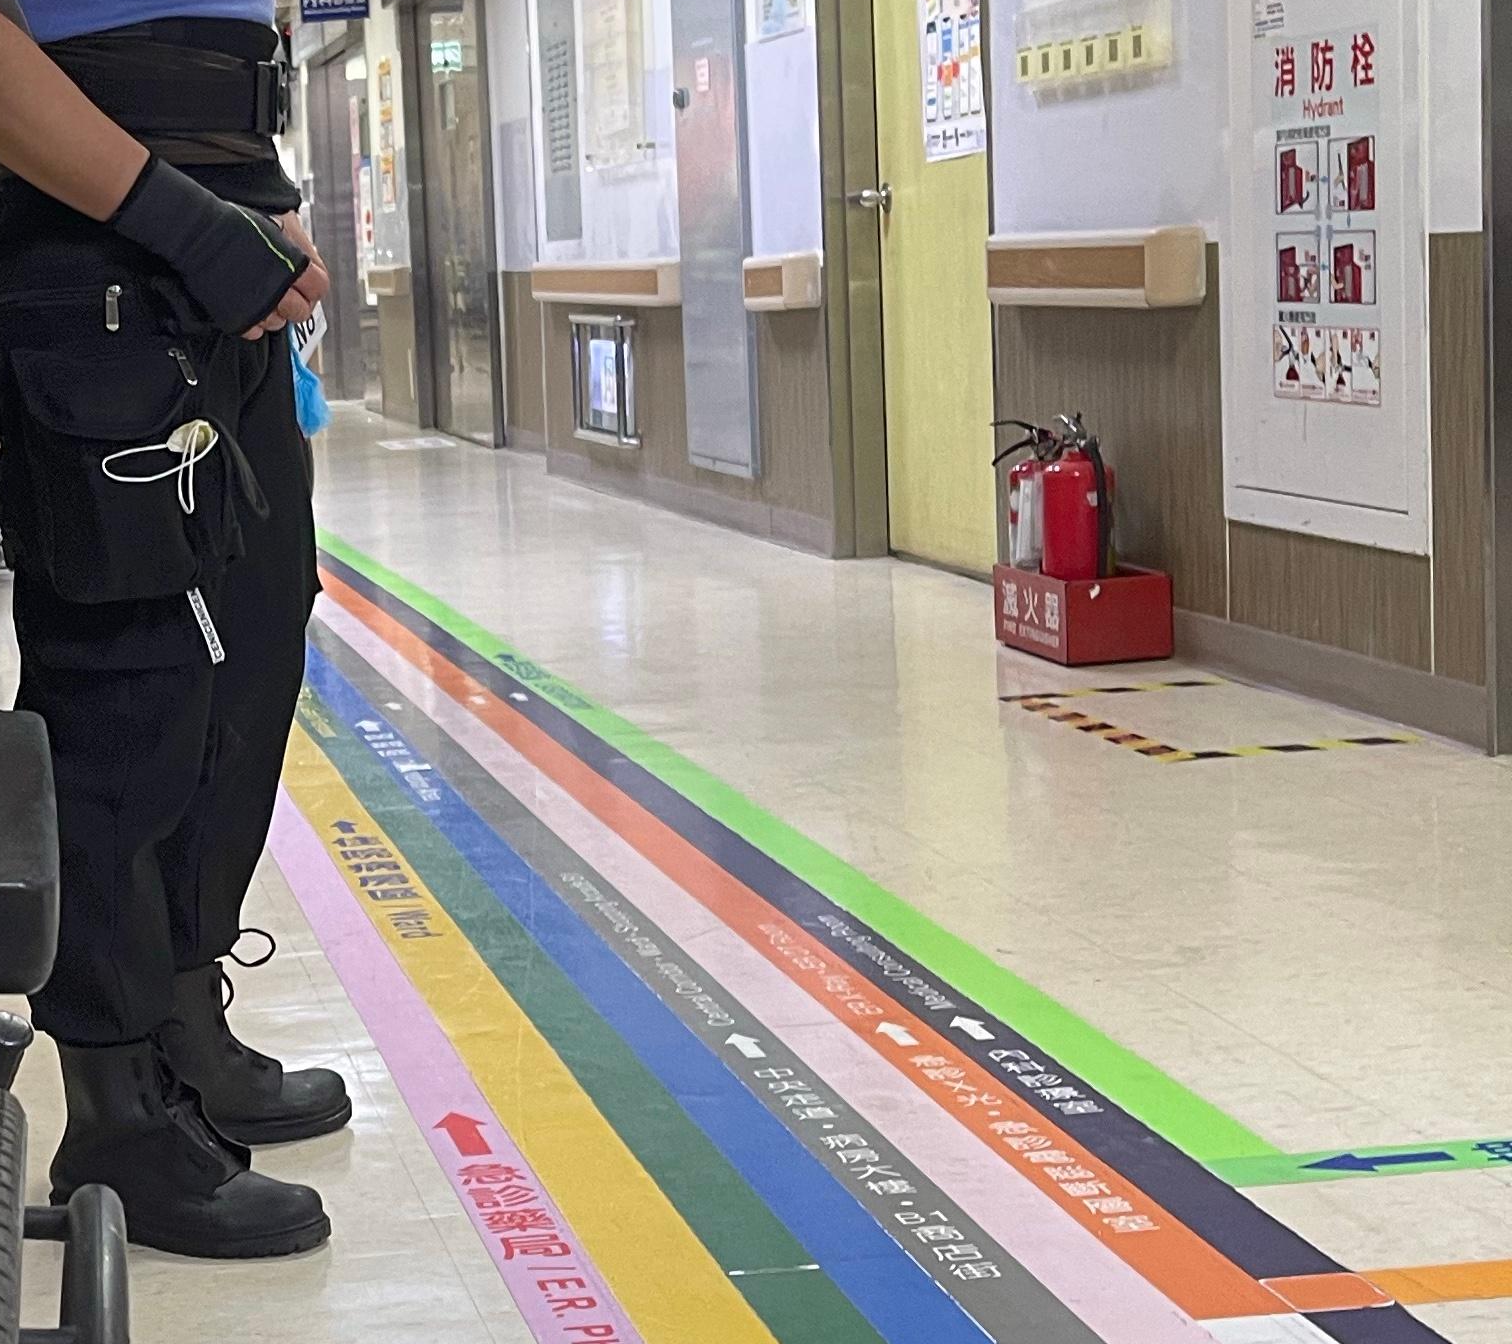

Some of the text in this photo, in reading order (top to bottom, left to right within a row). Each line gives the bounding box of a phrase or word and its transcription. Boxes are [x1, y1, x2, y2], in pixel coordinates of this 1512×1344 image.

[1274, 32, 1375, 98] 消防栓
[1302, 96, 1344, 121] Hydrant
[386, 909, 444, 938] Ward
[456, 1161, 572, 1261] 急診藥局
[536, 1276, 598, 1320] E.R.
